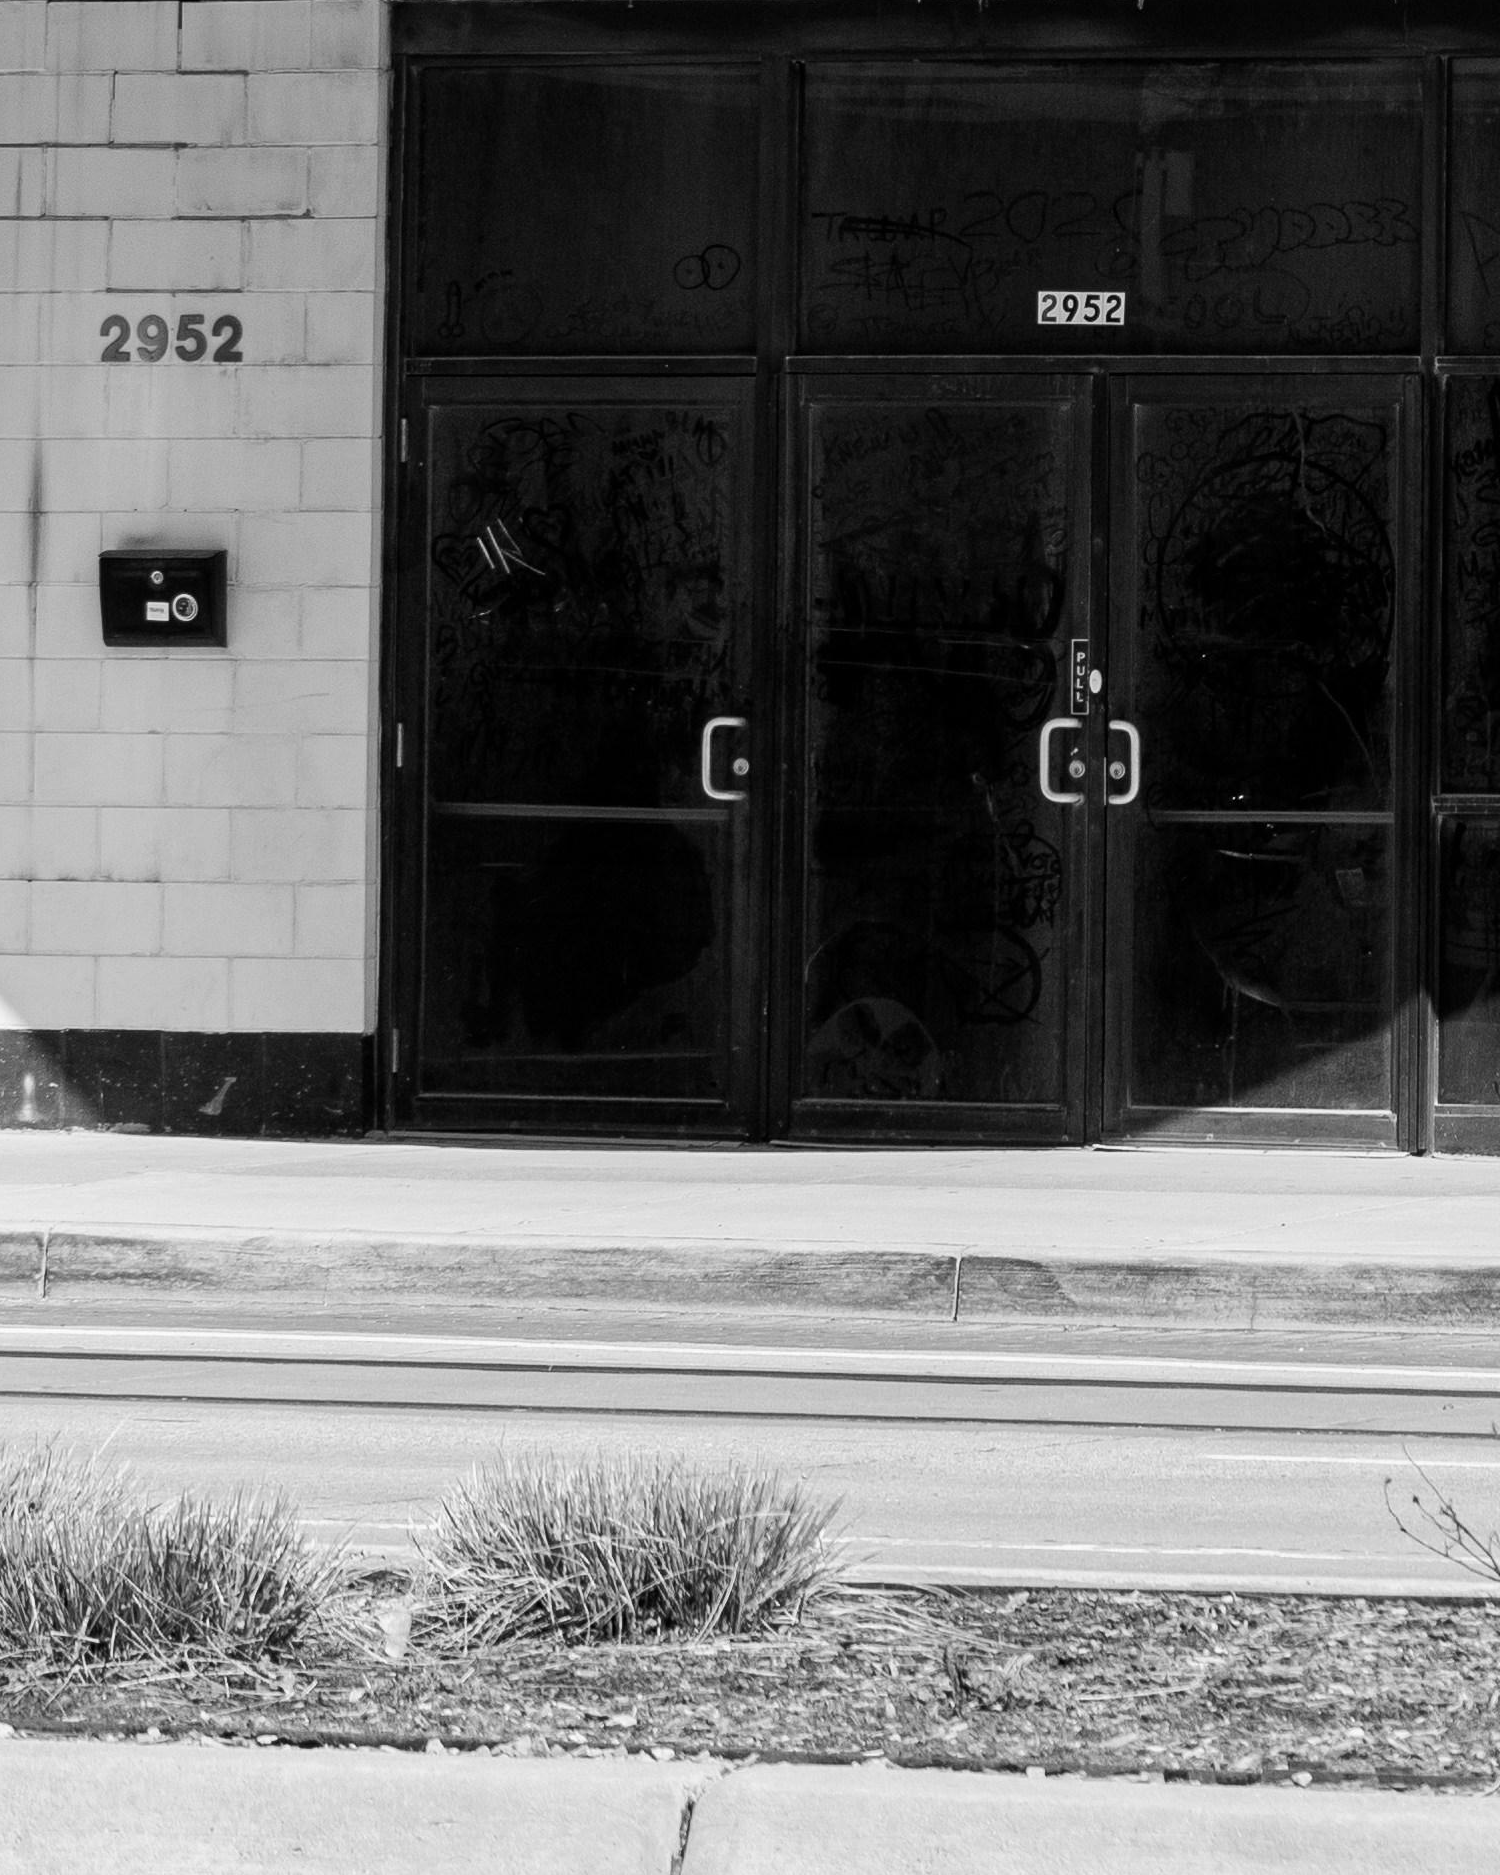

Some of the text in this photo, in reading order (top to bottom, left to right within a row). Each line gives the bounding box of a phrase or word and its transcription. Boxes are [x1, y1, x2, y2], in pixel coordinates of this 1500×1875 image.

[1041, 293, 1122, 323] 2952
[100, 314, 243, 362] 2952
[1076, 651, 1086, 703] PULL
